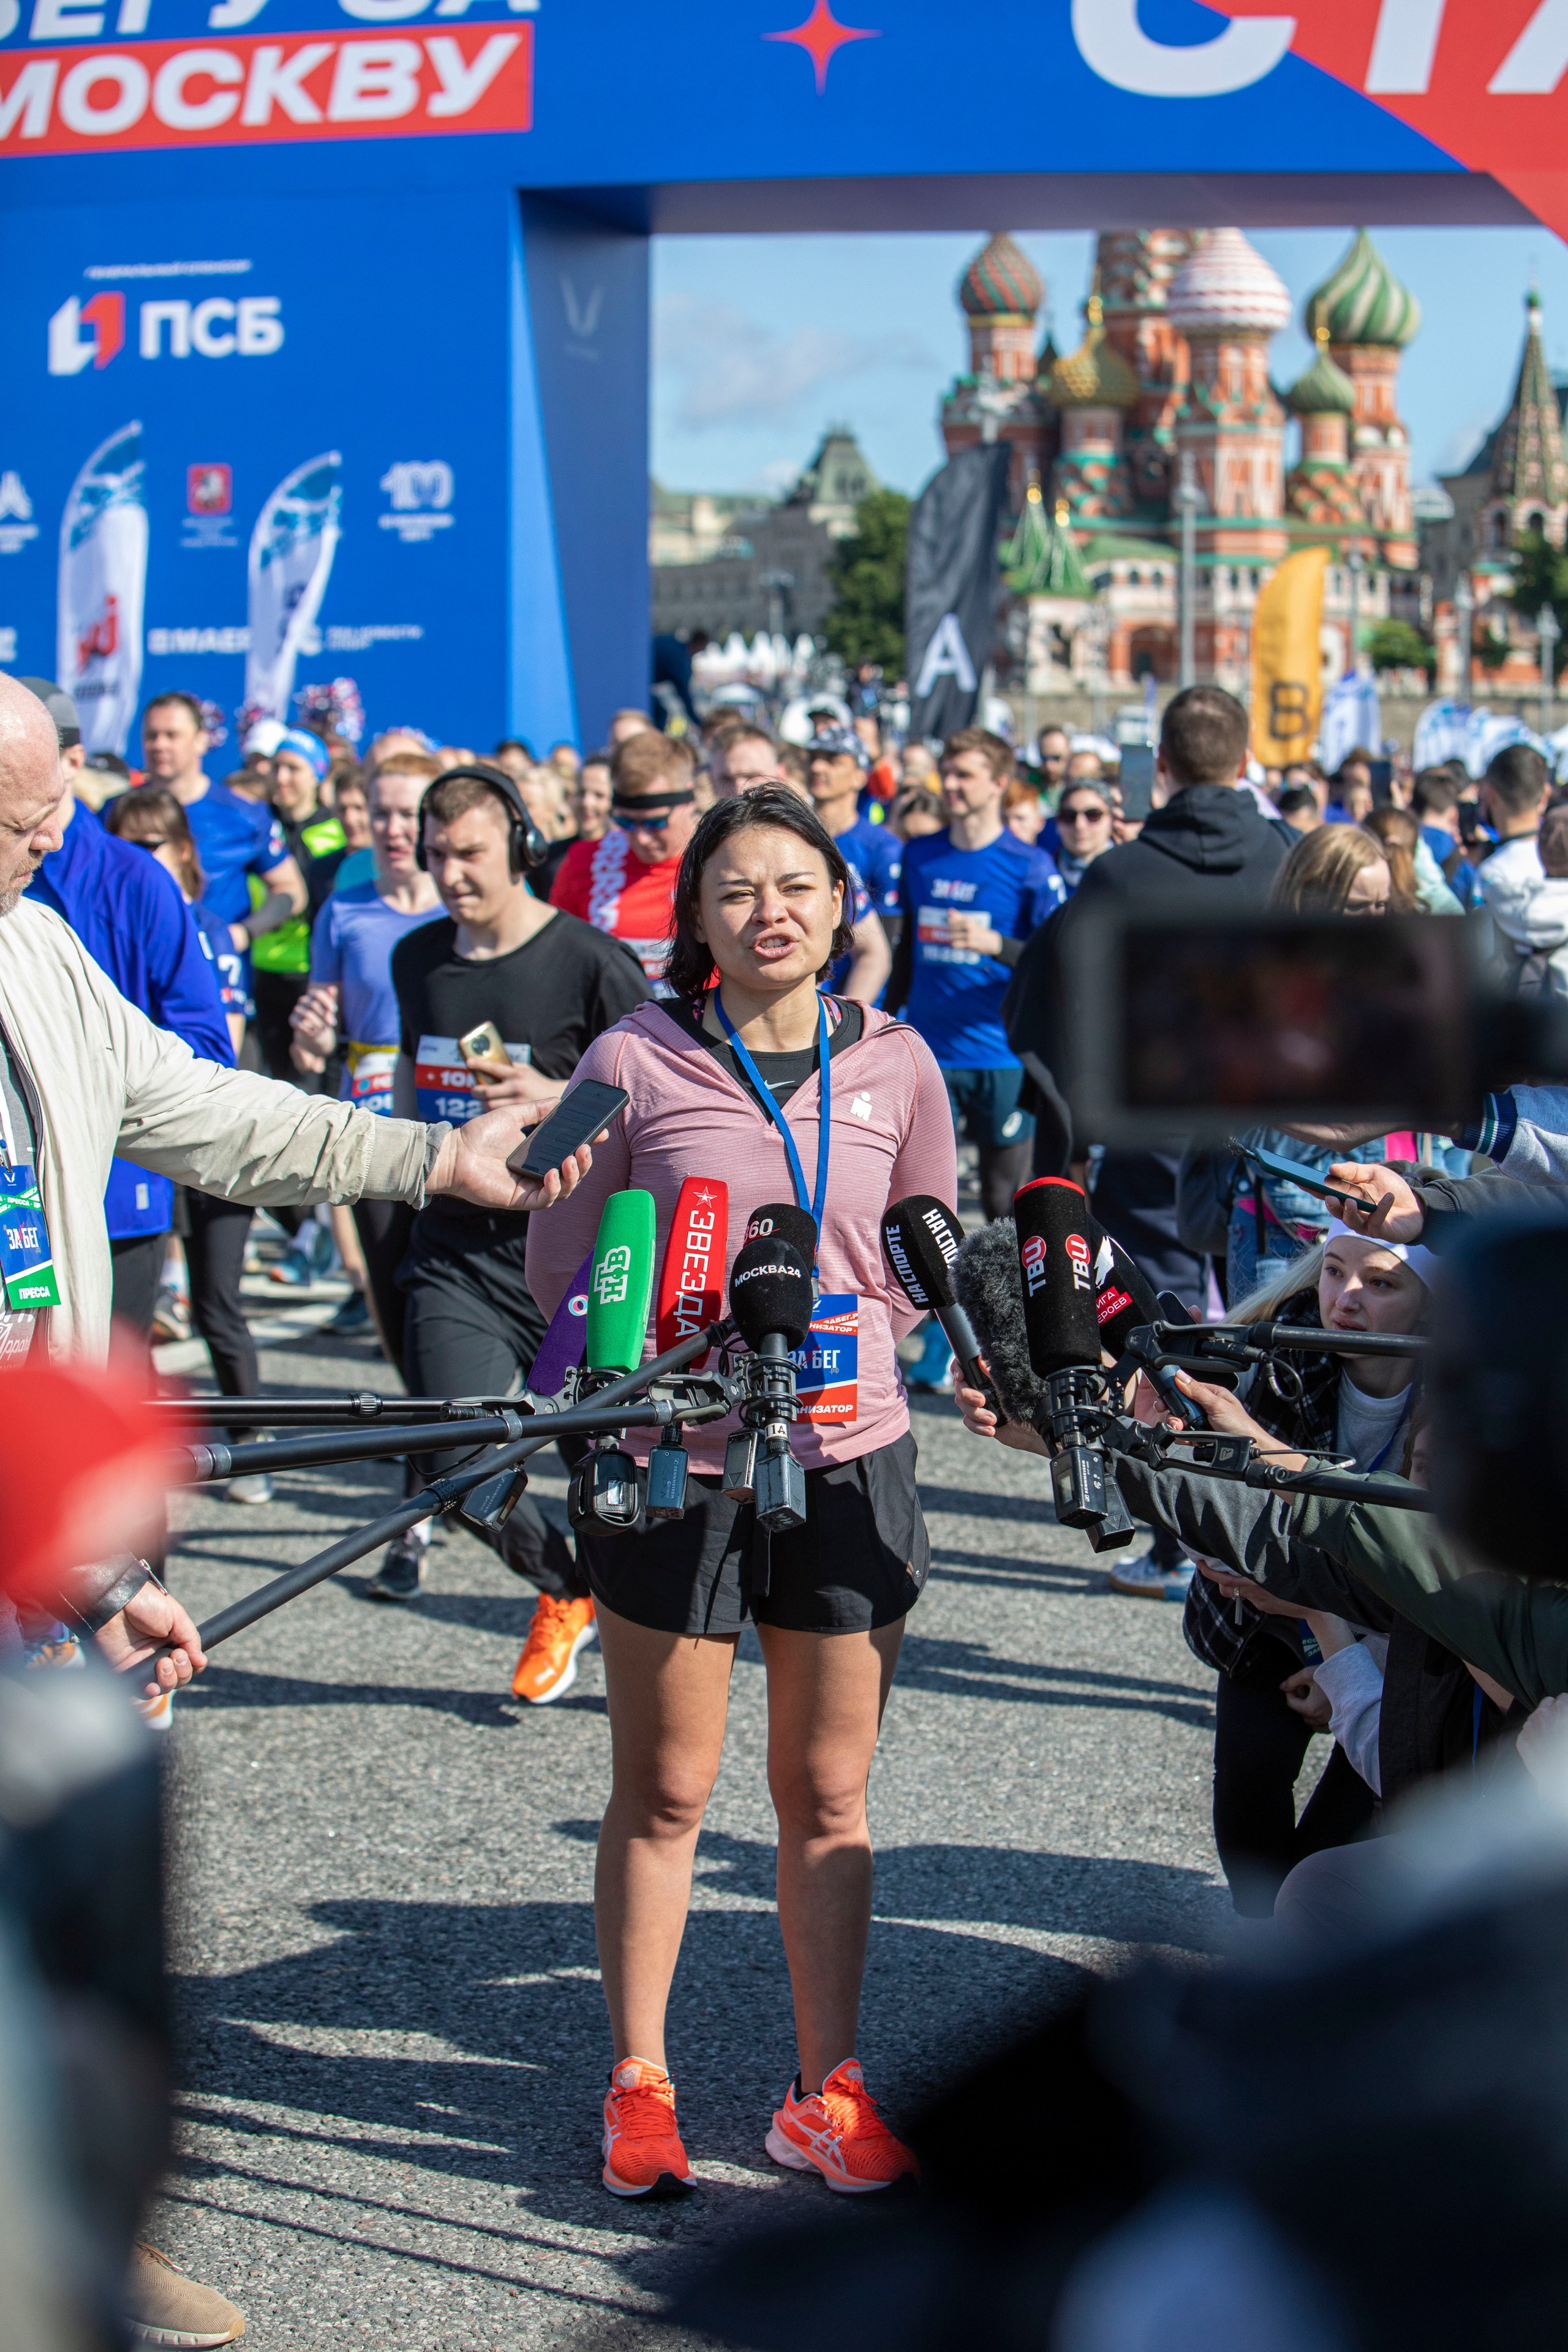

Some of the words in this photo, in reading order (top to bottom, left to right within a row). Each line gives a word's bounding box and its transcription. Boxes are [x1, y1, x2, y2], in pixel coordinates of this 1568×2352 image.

[140, 296, 284, 358] ПСБ
[916, 612, 977, 697] A
[744, 1218, 774, 1240] 60
[886, 1224, 917, 1283] СПОРТЕ
[922, 1208, 947, 1235] НА
[935, 1229, 959, 1269] СПО
[18, 1286, 51, 1300] ПРЕССА
[673, 1210, 715, 1338] ЗВЕЗДА
[907, 1283, 929, 1303] НА
[1025, 1238, 1046, 1297] ТВЦ
[1070, 1240, 1091, 1291] ТВЦ
